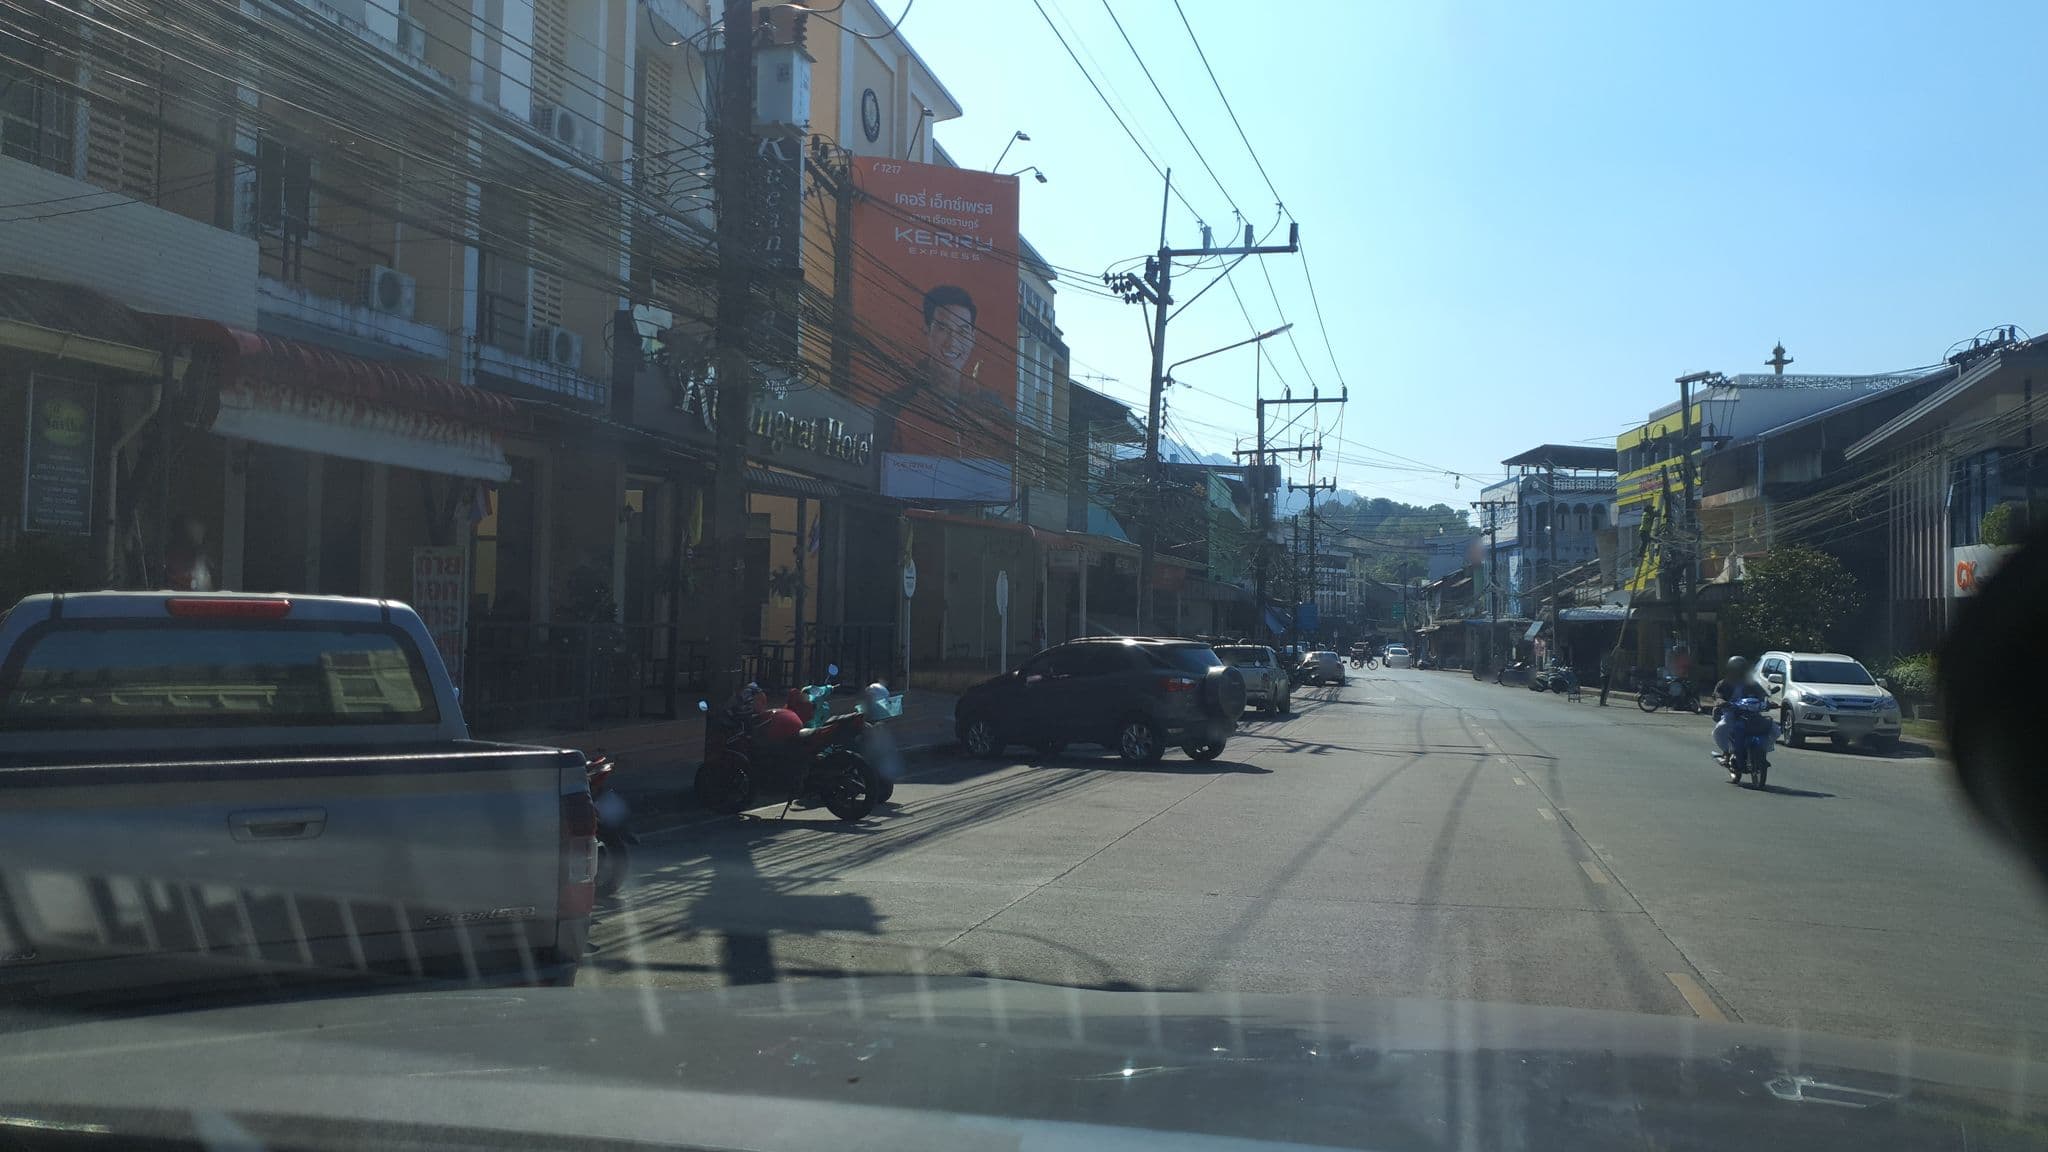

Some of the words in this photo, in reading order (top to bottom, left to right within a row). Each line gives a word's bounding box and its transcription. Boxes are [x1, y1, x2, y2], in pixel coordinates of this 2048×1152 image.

[882, 163, 902, 175] 1217
[895, 187, 926, 207] เคอรี่
[930, 191, 993, 216] เอ็กซ์เพรส
[895, 226, 993, 252] KERRY
[908, 247, 982, 262] EXPRESS
